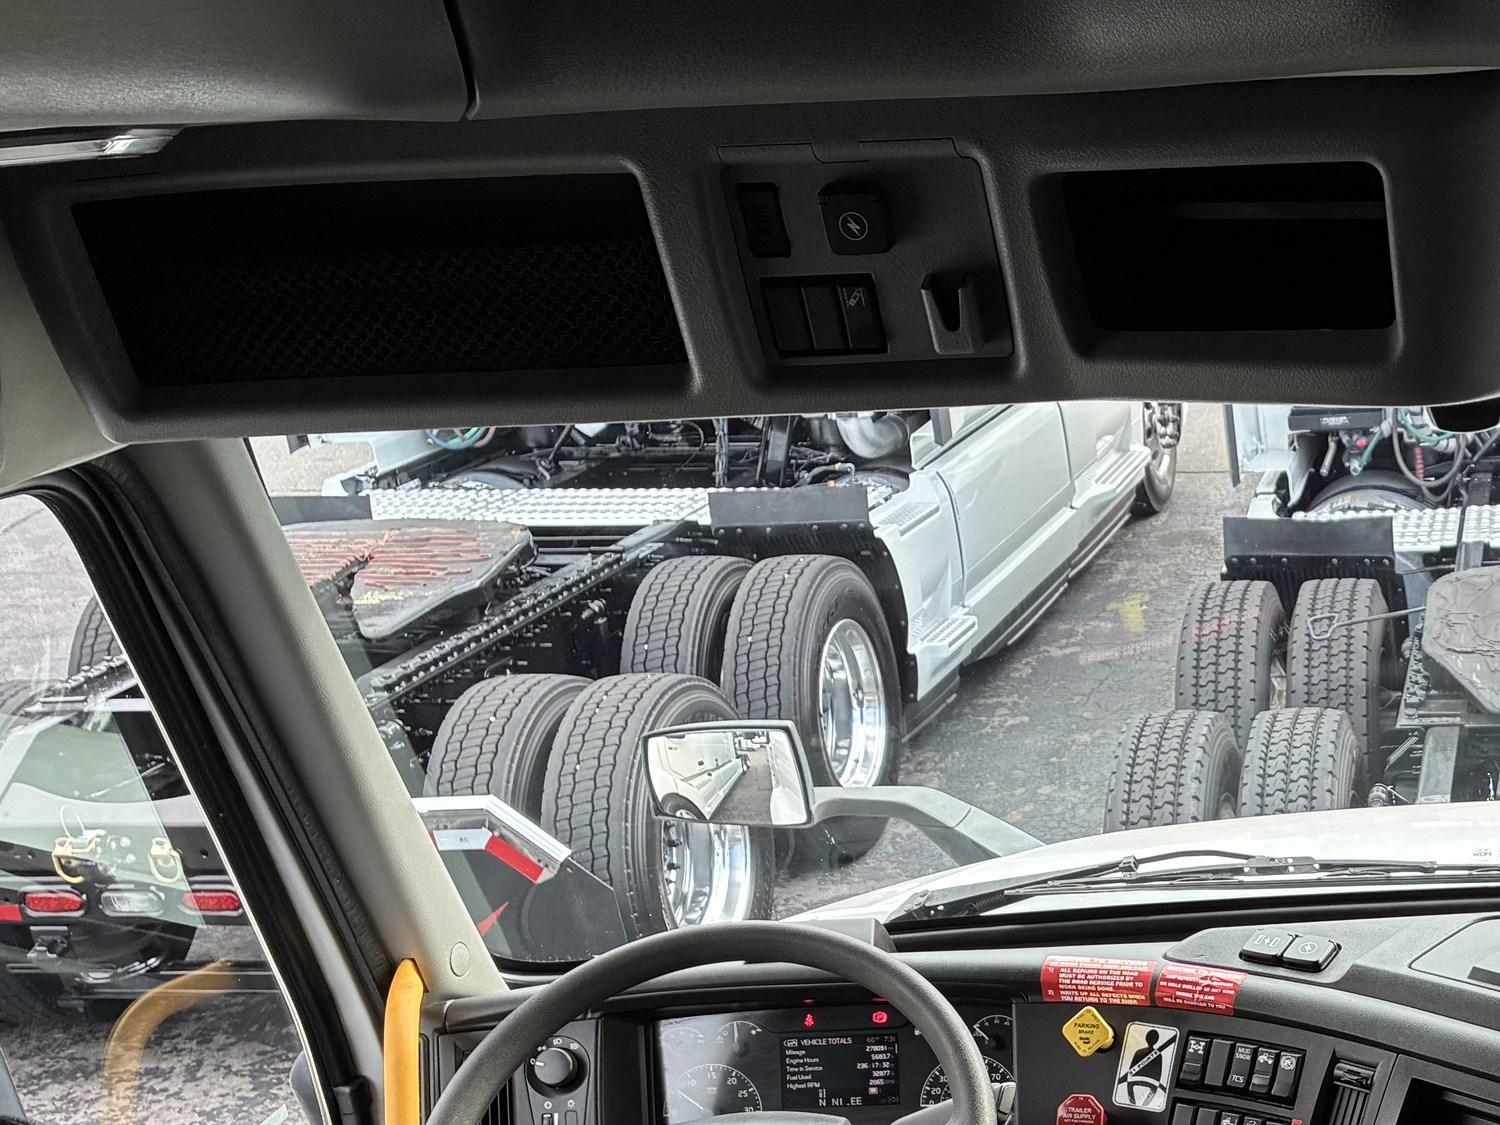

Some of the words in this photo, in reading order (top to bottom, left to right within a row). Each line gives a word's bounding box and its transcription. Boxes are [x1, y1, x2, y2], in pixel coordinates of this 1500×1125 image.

[800, 1038, 827, 1046] VEHICLE
[828, 1037, 853, 1045] TOTALS
[1235, 1052, 1251, 1060] SNOW
[785, 1057, 803, 1065] Engine
[707, 1072, 717, 1080] 15
[991, 1073, 1002, 1081] 70
[1231, 1074, 1245, 1083] TCS
[727, 1077, 738, 1085] 20
[787, 1082, 806, 1090] Highest
[738, 1089, 749, 1098] 25
[931, 1087, 942, 1095] 20
